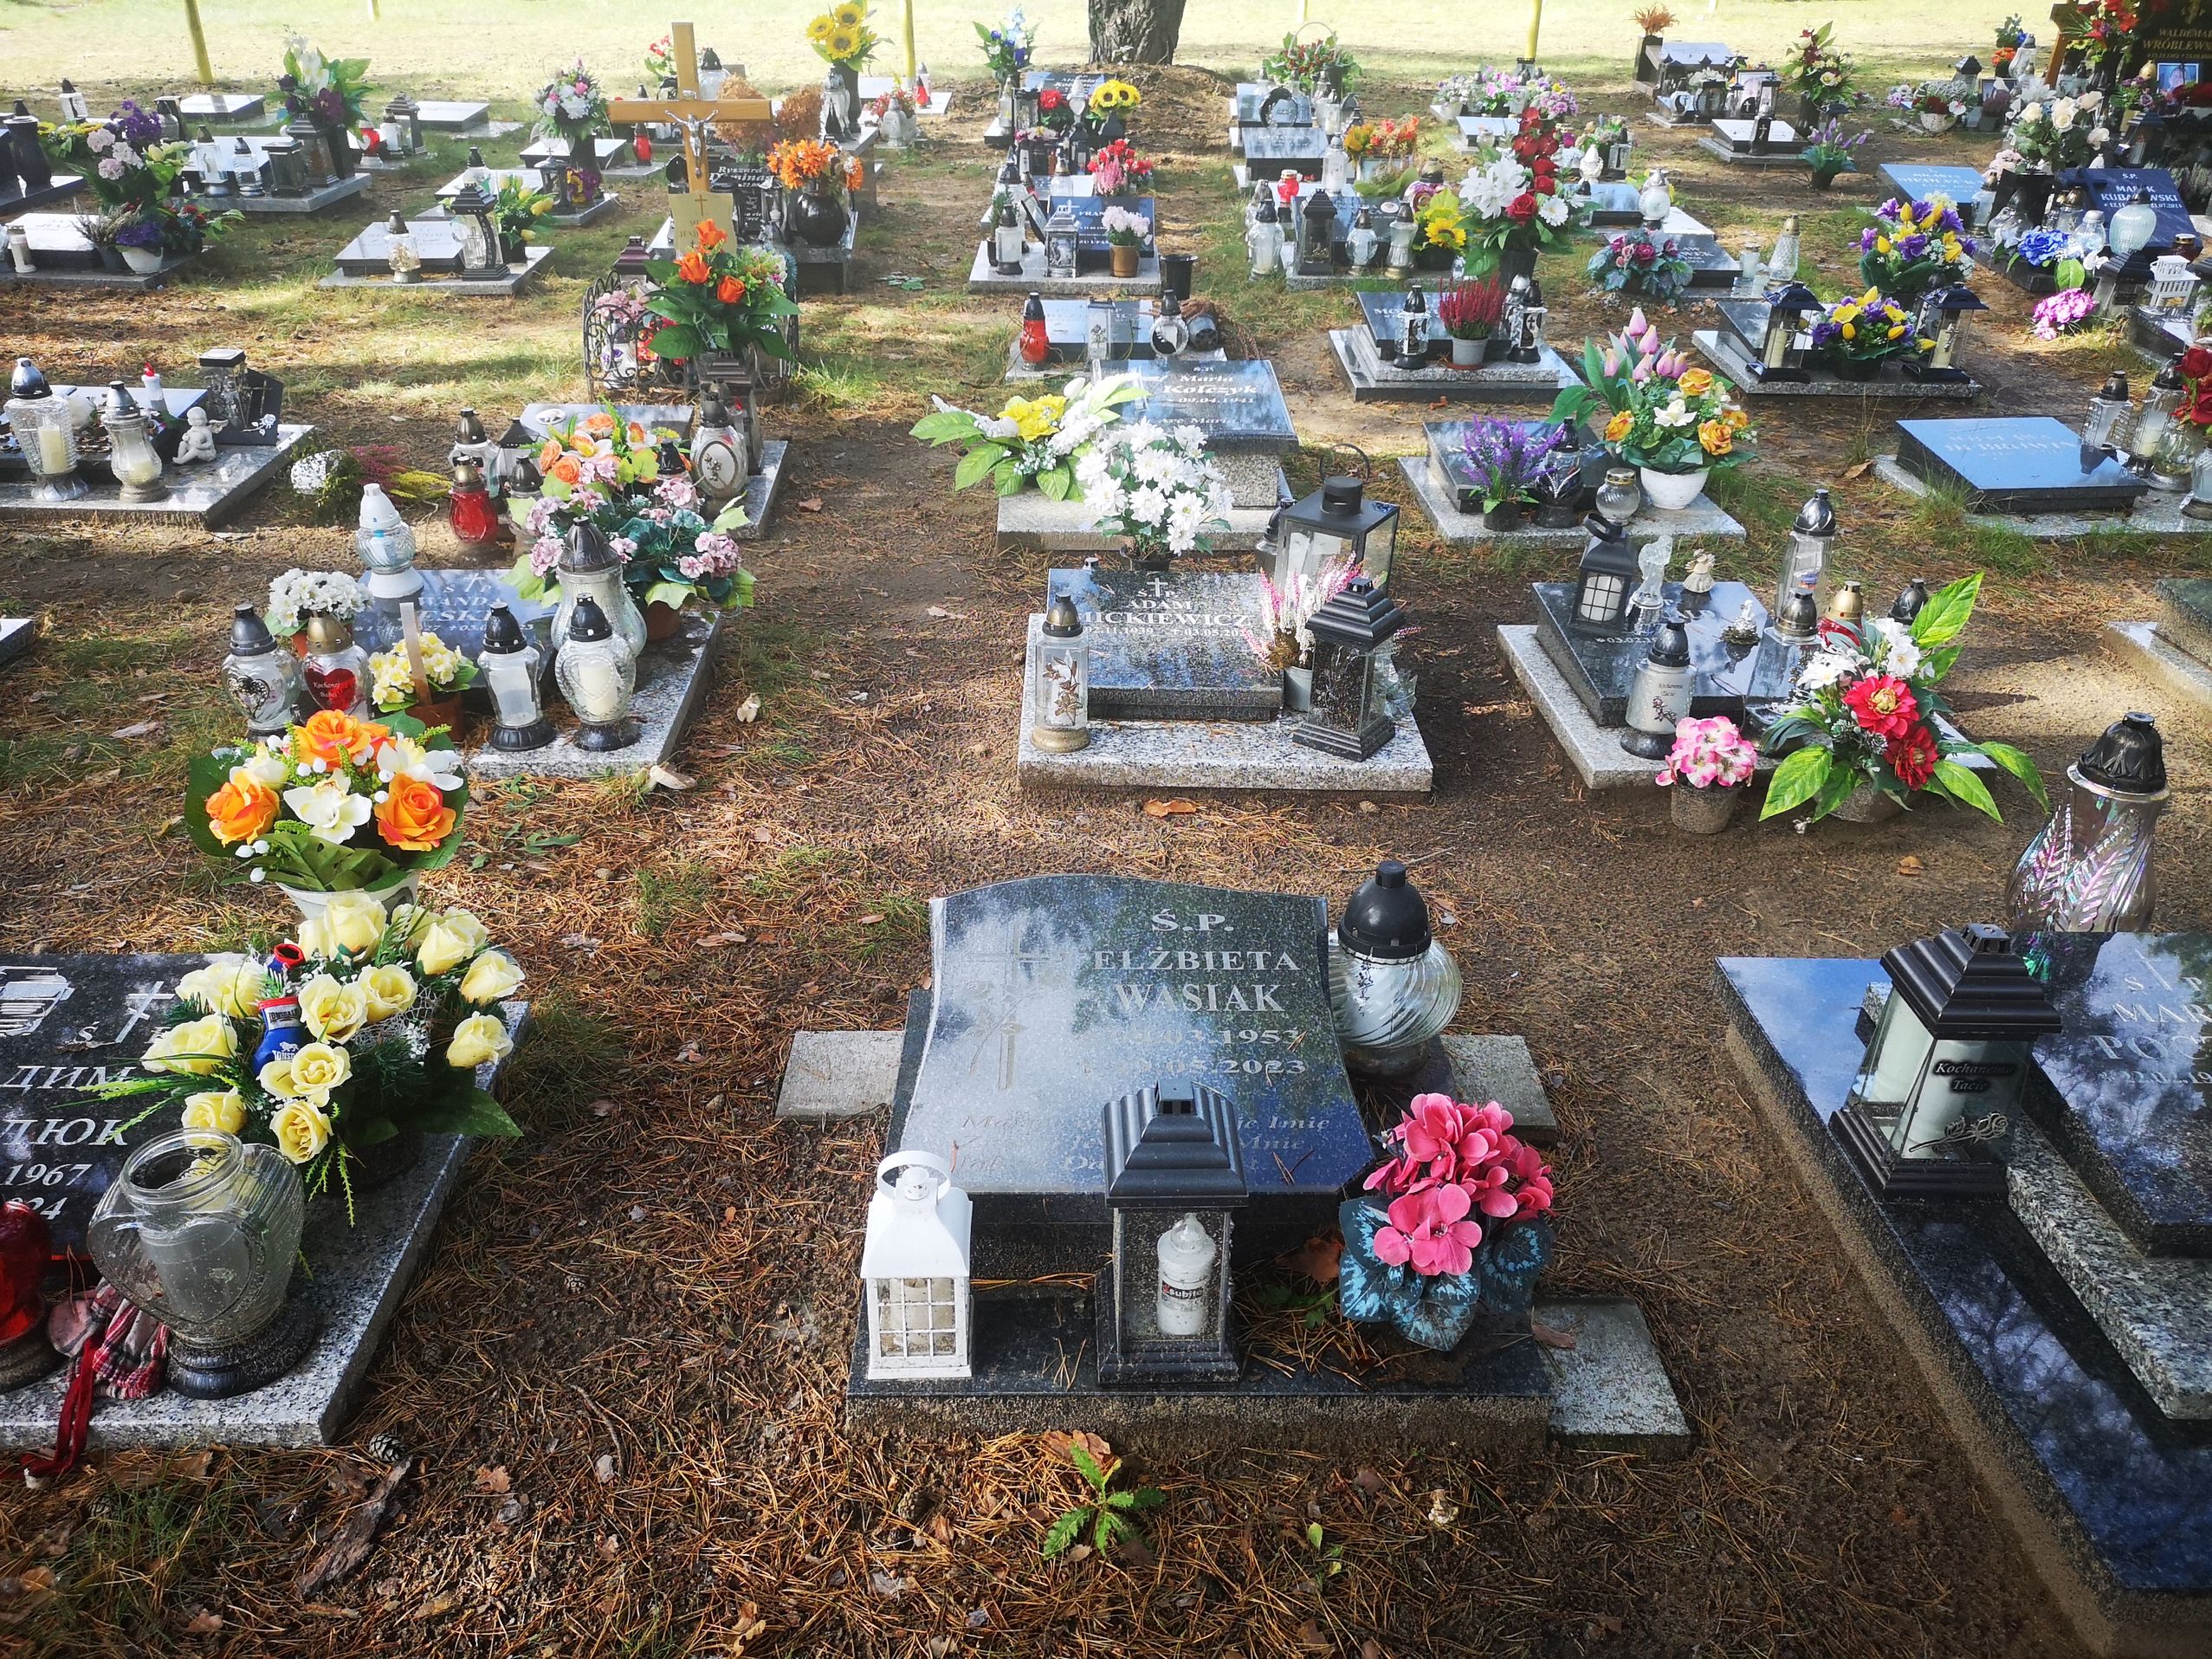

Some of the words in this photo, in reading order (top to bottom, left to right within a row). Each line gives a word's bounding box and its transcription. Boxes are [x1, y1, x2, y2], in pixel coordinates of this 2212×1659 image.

[1127, 599, 1193, 610] ADAM
[1152, 909, 1234, 931] Ś.P.
[1093, 946, 1301, 970] ELŻBIETA
[1115, 983, 1285, 1012] WASIAK
[2112, 1002, 2212, 1023] MAR
[0, 1163, 93, 1187] 1967
